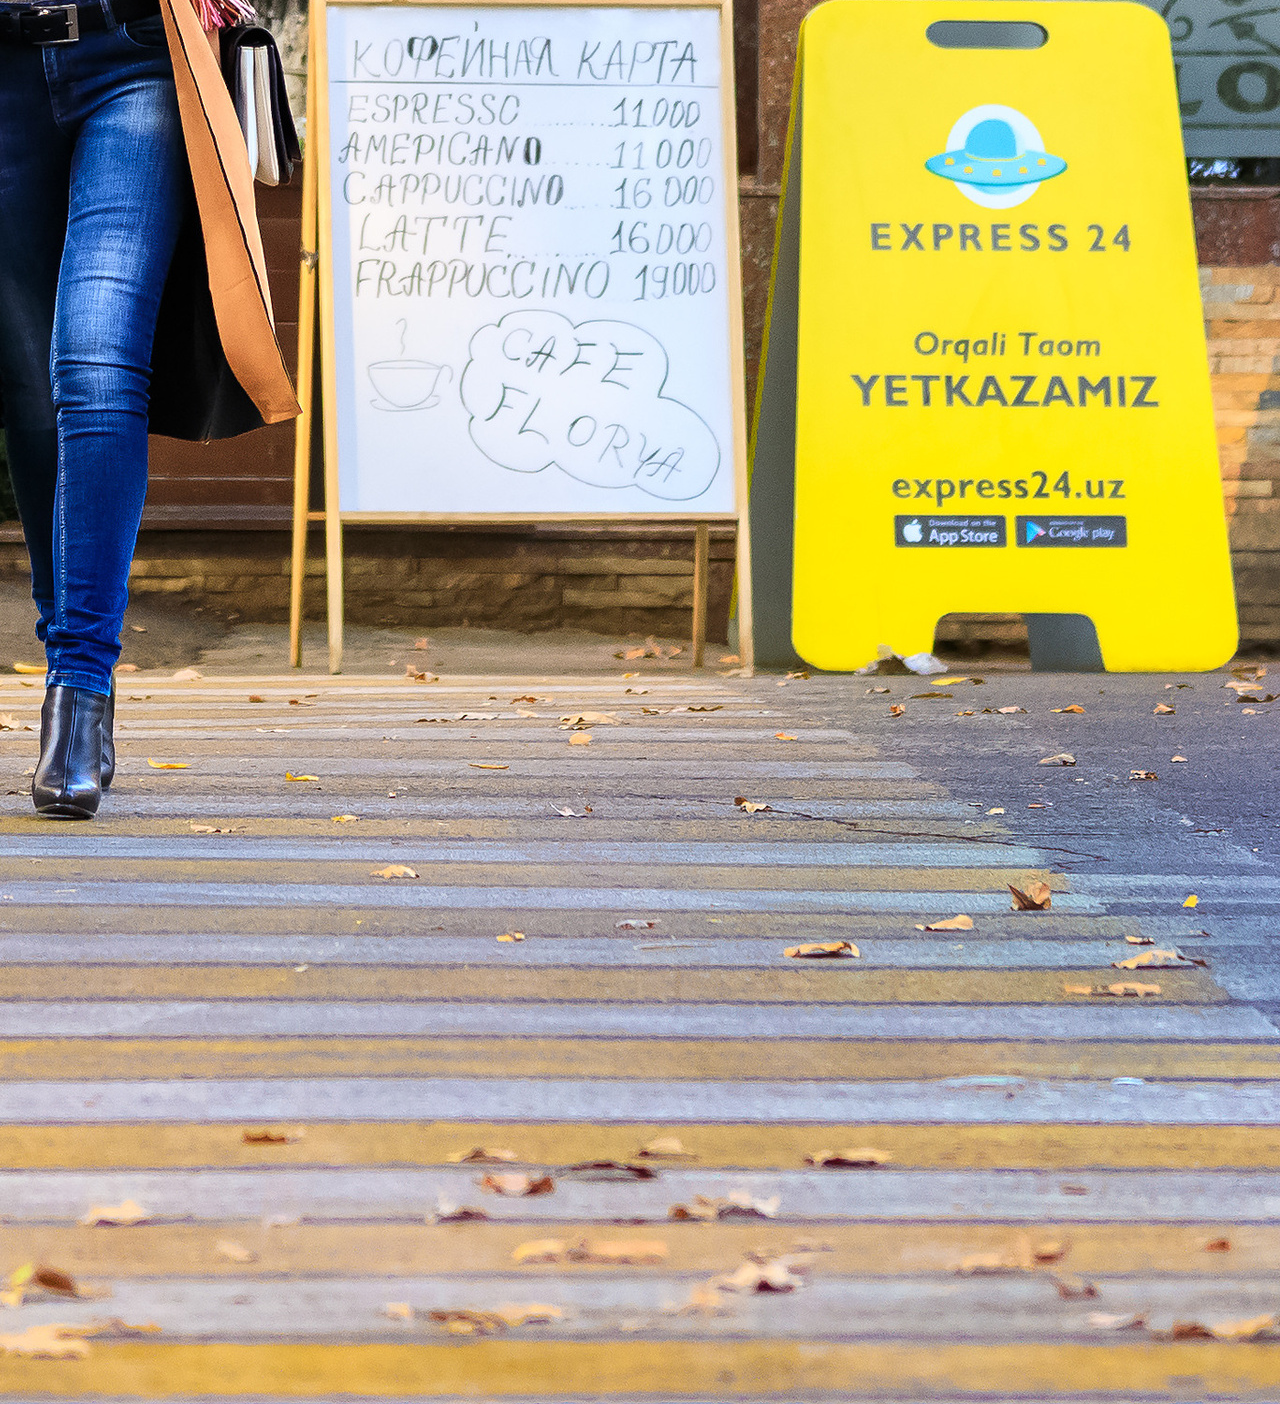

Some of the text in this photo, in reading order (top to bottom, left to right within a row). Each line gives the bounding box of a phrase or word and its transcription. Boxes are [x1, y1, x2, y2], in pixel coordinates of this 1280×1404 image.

[353, 21, 698, 84] КОФЕЙНАЯ КАРТА
[348, 92, 520, 125] ESPRESSO
[343, 171, 564, 208] CAPPUCCINO
[358, 212, 513, 256] LATTE
[870, 222, 1133, 252] EXPRESS 24
[356, 258, 610, 299] FRAPPUCCINO
[502, 328, 644, 390] CAFE
[914, 331, 1101, 364] Orqali Taom
[851, 374, 1160, 409] YETKAZAMIZ
[485, 382, 685, 484] FLORYA
[892, 470, 1126, 508] express24.uz
[929, 528, 999, 546] App Store
